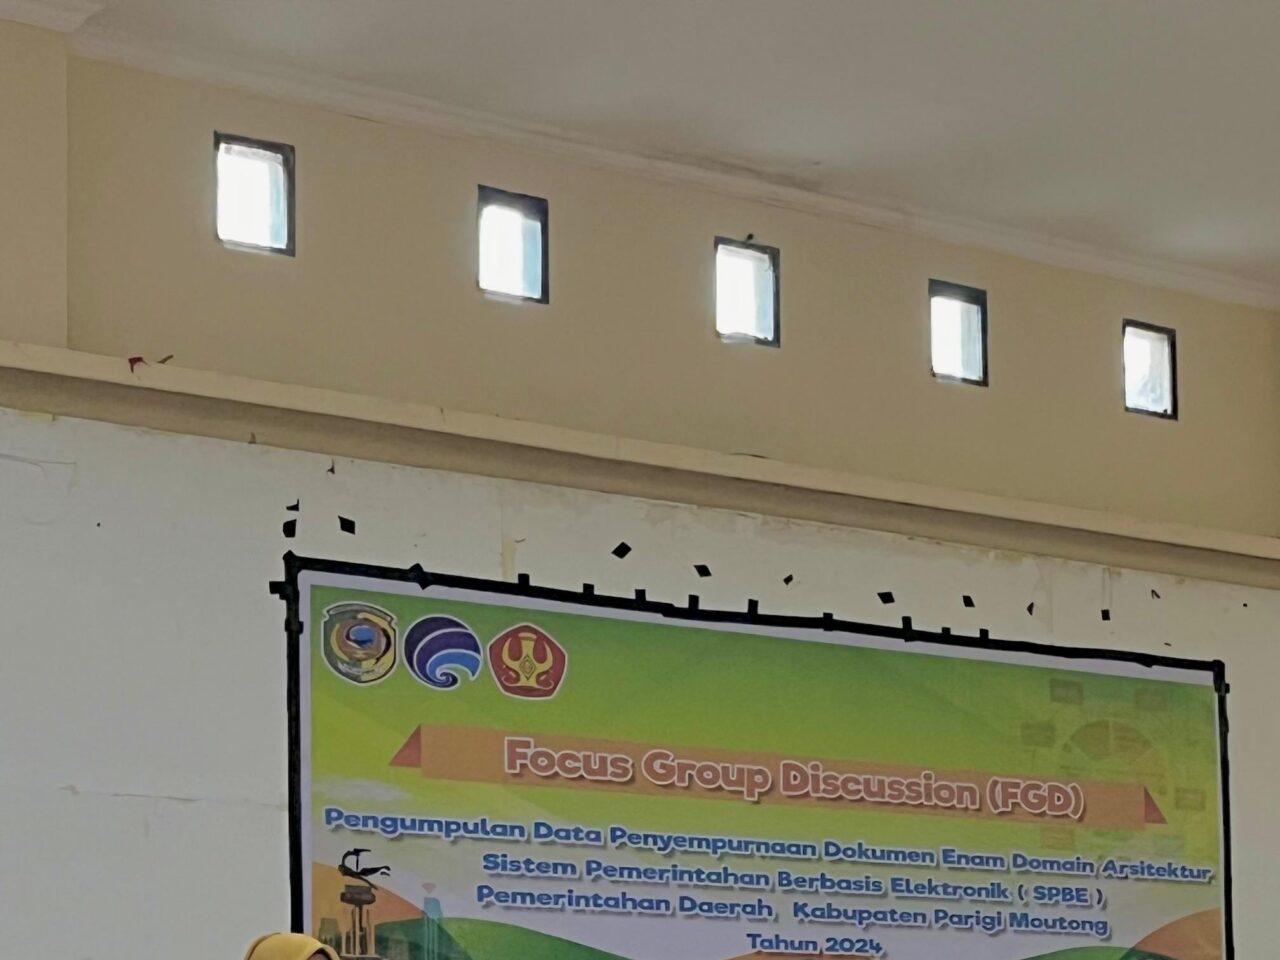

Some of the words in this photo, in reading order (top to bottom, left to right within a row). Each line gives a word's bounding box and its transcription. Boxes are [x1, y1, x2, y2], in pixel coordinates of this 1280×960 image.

[505, 736, 634, 782] Focus
[641, 749, 772, 801] Group
[780, 760, 979, 809] Discussion
[986, 776, 1085, 820] (FGD)
[324, 807, 526, 840] Pengumpulan
[533, 821, 602, 843] Data
[609, 826, 817, 857] Penyempurnaan
[823, 840, 935, 866] Dokumen
[941, 849, 1005, 869] Enam
[1012, 853, 1095, 875] Domain
[1101, 860, 1212, 882] Arsitektur
[482, 853, 577, 876] Sistem
[585, 859, 770, 887] Pemerintahan
[777, 871, 883, 894] Berbasis
[890, 877, 1009, 901] Elektronik
[1032, 885, 1089, 905] SPBE
[476, 884, 671, 912] Pemerintahan
[678, 895, 773, 917] Daerah
[792, 901, 928, 927] Kabupaten
[934, 909, 1003, 932] Parigi
[1008, 912, 1109, 936] Moutong
[746, 933, 818, 951] Tahun
[825, 937, 883, 954] 2024
